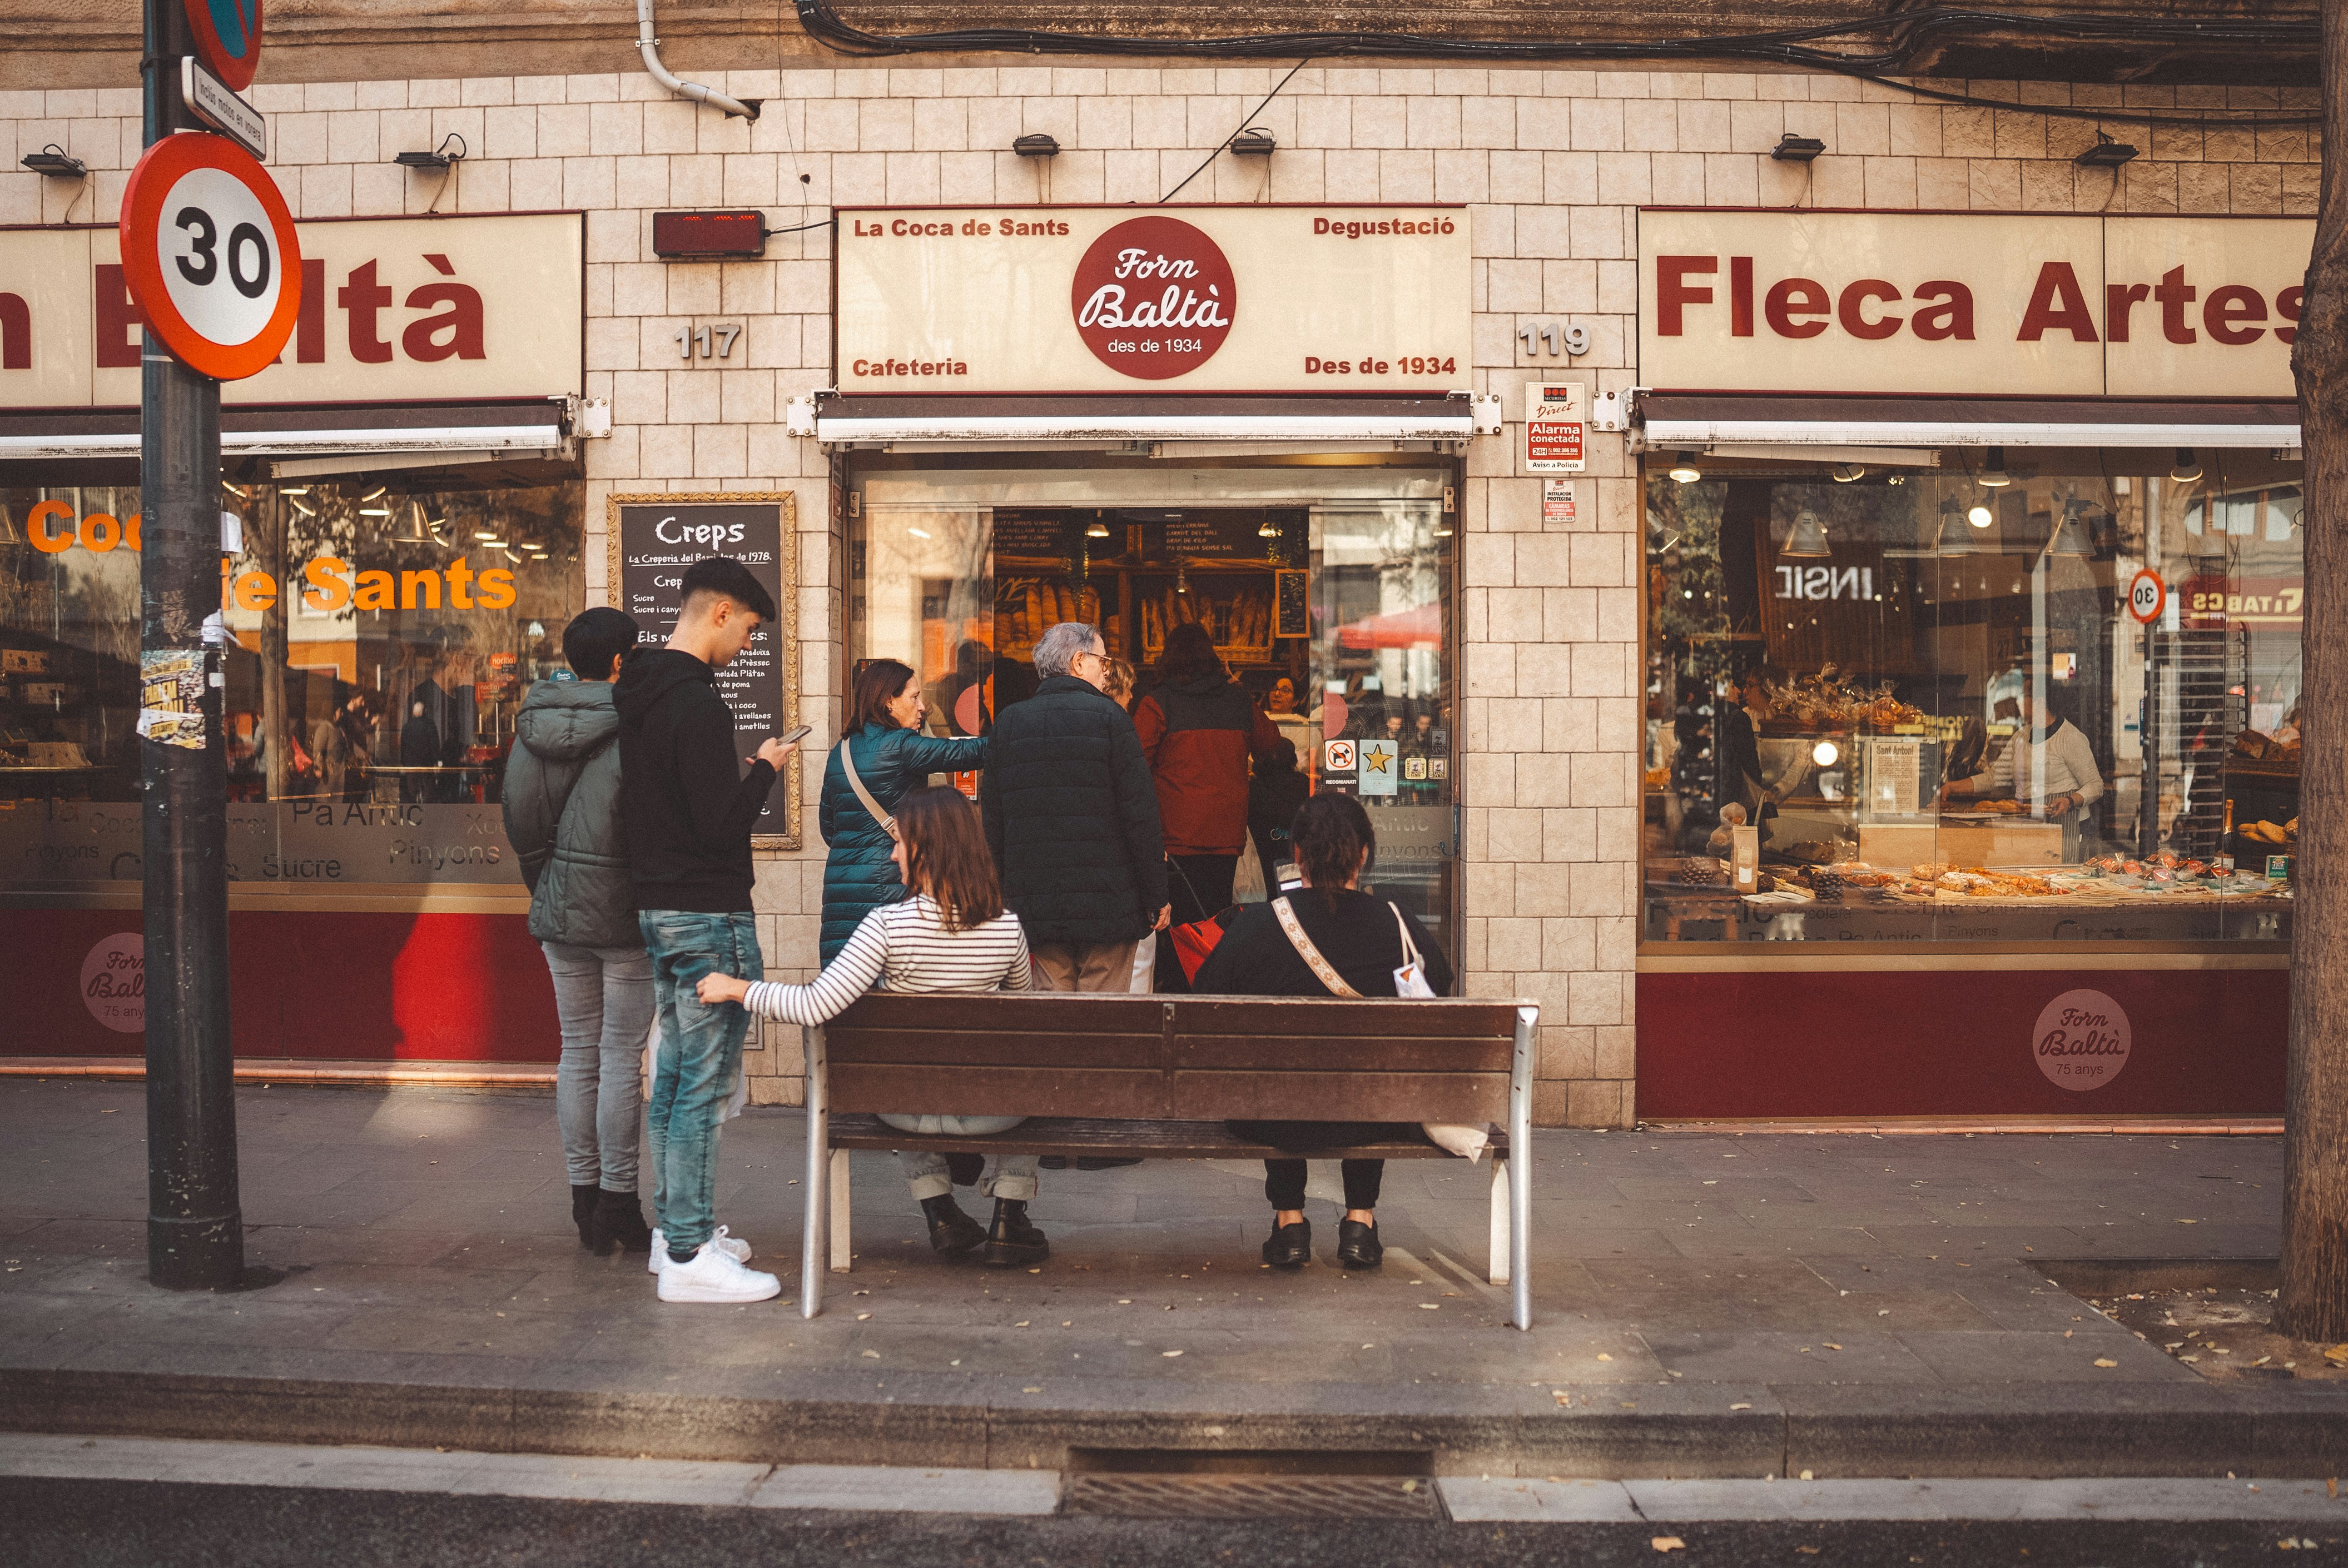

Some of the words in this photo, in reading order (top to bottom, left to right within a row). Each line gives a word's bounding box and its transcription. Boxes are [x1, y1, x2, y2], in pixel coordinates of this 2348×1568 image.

[236, 114, 243, 127] en
[854, 220, 884, 237] La
[891, 219, 954, 237] Coca
[961, 219, 991, 236] de
[999, 218, 1070, 236] Sants
[1313, 216, 1456, 239] Degustació
[175, 207, 270, 298] 30
[1114, 248, 1200, 279] Forn
[1078, 283, 1229, 328] Baltà
[1657, 256, 1977, 341] Fleca
[96, 254, 487, 367] ltà
[674, 323, 741, 359] 117
[1108, 339, 1136, 352] des
[1140, 339, 1160, 352] de
[1164, 339, 1202, 352] 1934
[1519, 322, 1590, 356] 119
[852, 358, 968, 376] Cafeteria
[1304, 357, 1351, 375] Des
[1358, 357, 1389, 375] de
[1397, 357, 1457, 375] 1934
[1531, 423, 1580, 434] Alarma
[1530, 434, 1580, 443] conectada
[655, 516, 746, 551] Creps
[642, 554, 679, 565] Creperia
[681, 553, 693, 562] del
[748, 552, 772, 562] 1978.
[221, 557, 277, 612] e
[302, 555, 518, 612] Sants
[633, 594, 655, 602] Sucre
[638, 631, 658, 643] Els
[739, 659, 771, 667] Prèssec
[389, 839, 500, 871] Pinyons
[262, 853, 341, 878] Sucre
[105, 1005, 120, 1017] 75
[2060, 1008, 2109, 1027] Forn
[2038, 1029, 2126, 1057] Baltà
[2056, 1063, 2071, 1074] 75
[2075, 1065, 2104, 1077] anys
